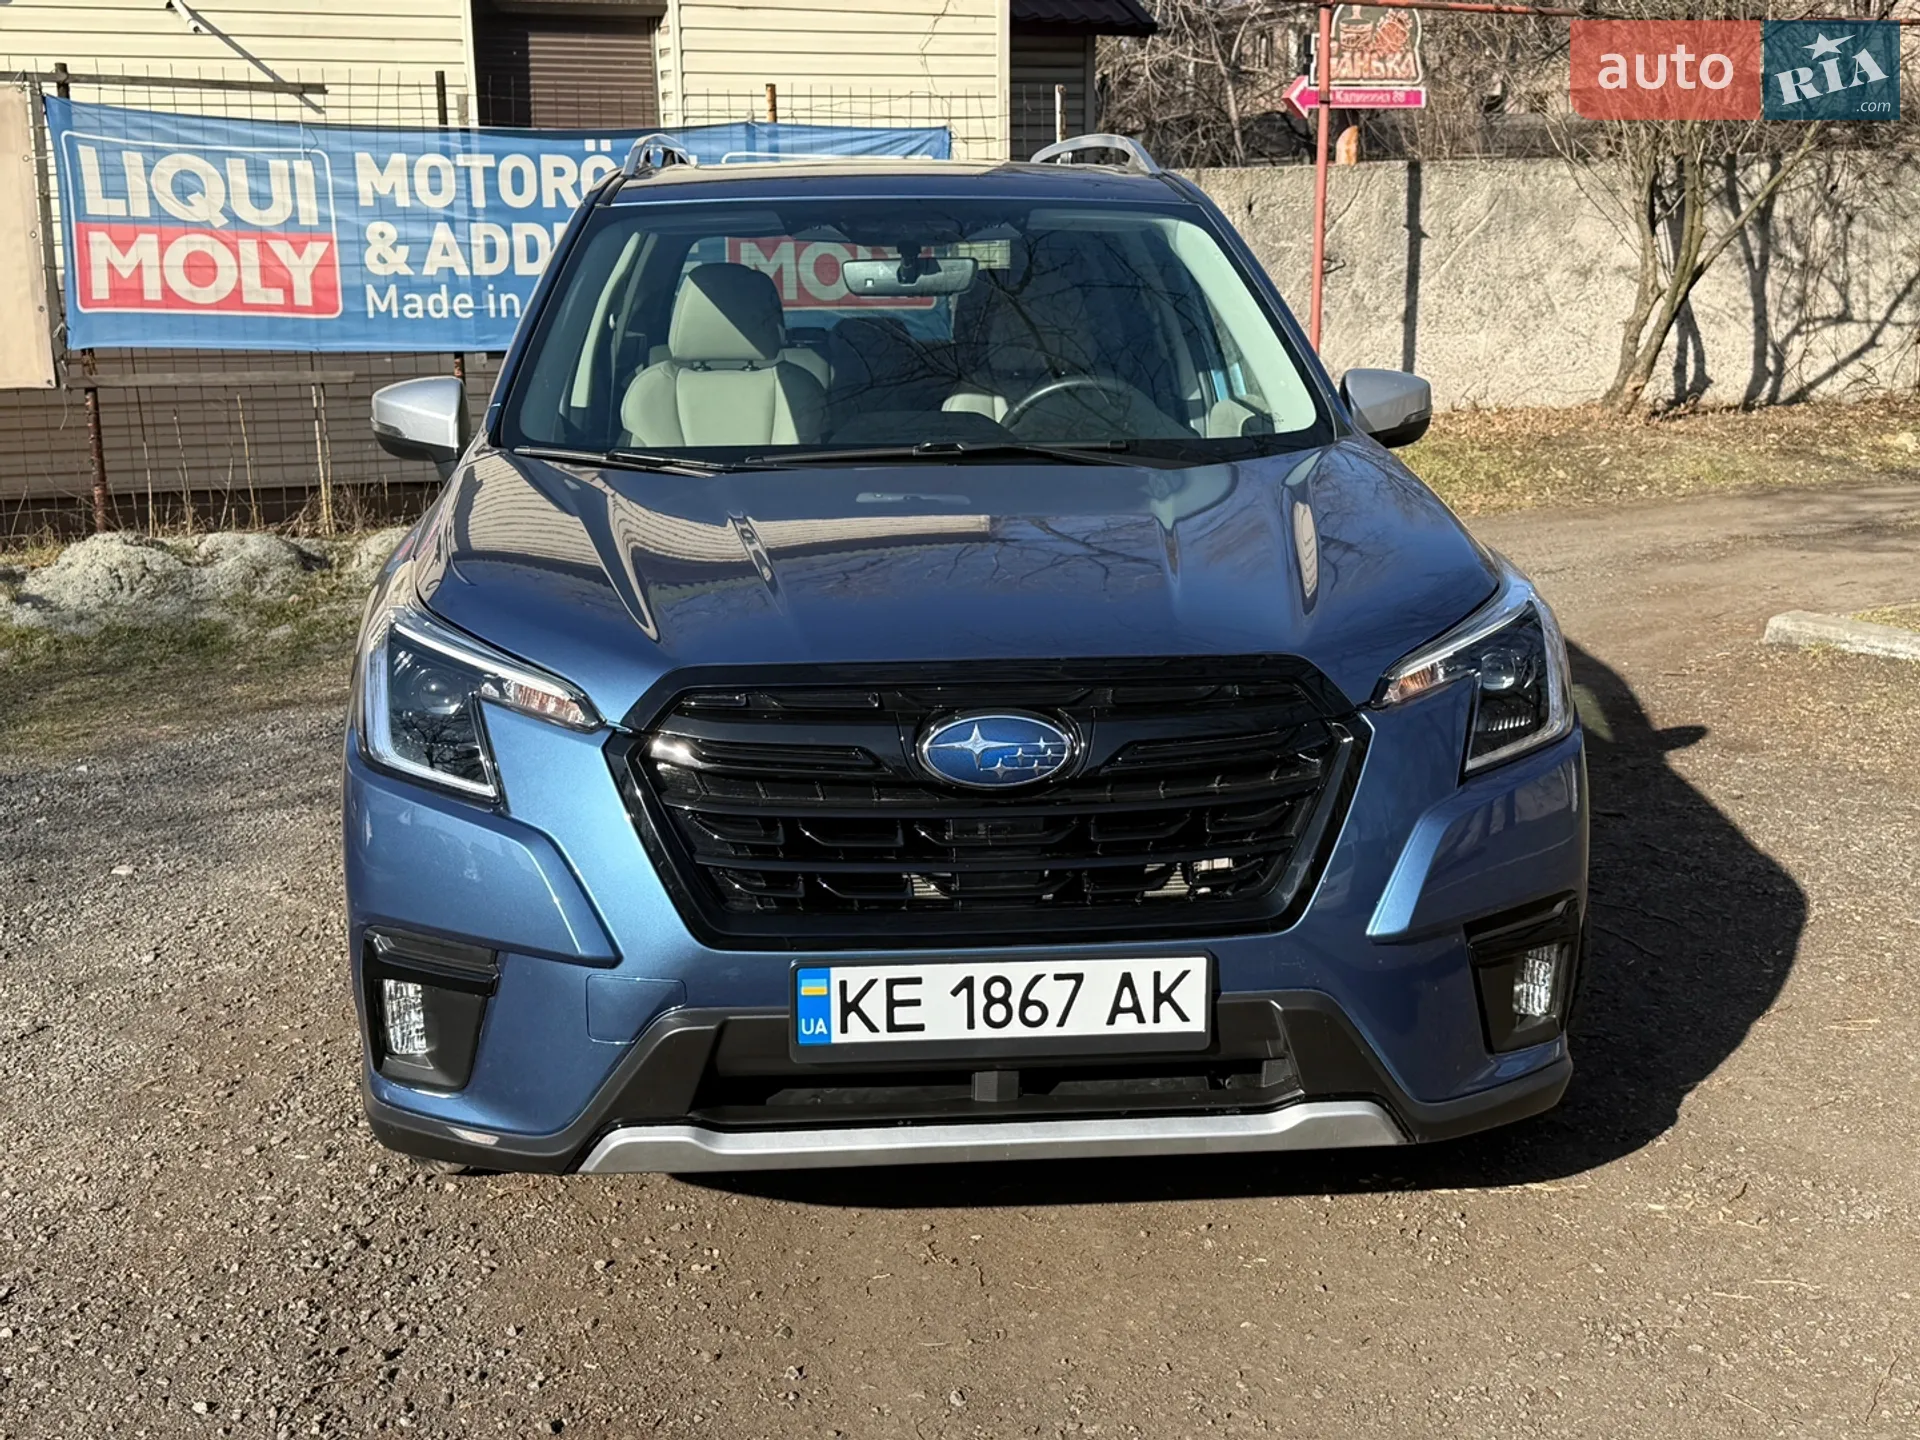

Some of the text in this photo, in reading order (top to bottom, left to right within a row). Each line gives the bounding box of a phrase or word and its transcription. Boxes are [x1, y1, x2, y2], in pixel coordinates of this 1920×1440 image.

[77, 144, 319, 228] LIQUI
[354, 138, 626, 209] MOTORÖ
[88, 232, 330, 307] MOLY
[363, 220, 415, 276] &
[740, 241, 932, 300] MO
[365, 283, 521, 319] Made in
[801, 1017, 828, 1036] UA
[838, 969, 1192, 1034] KE 1867 AK
